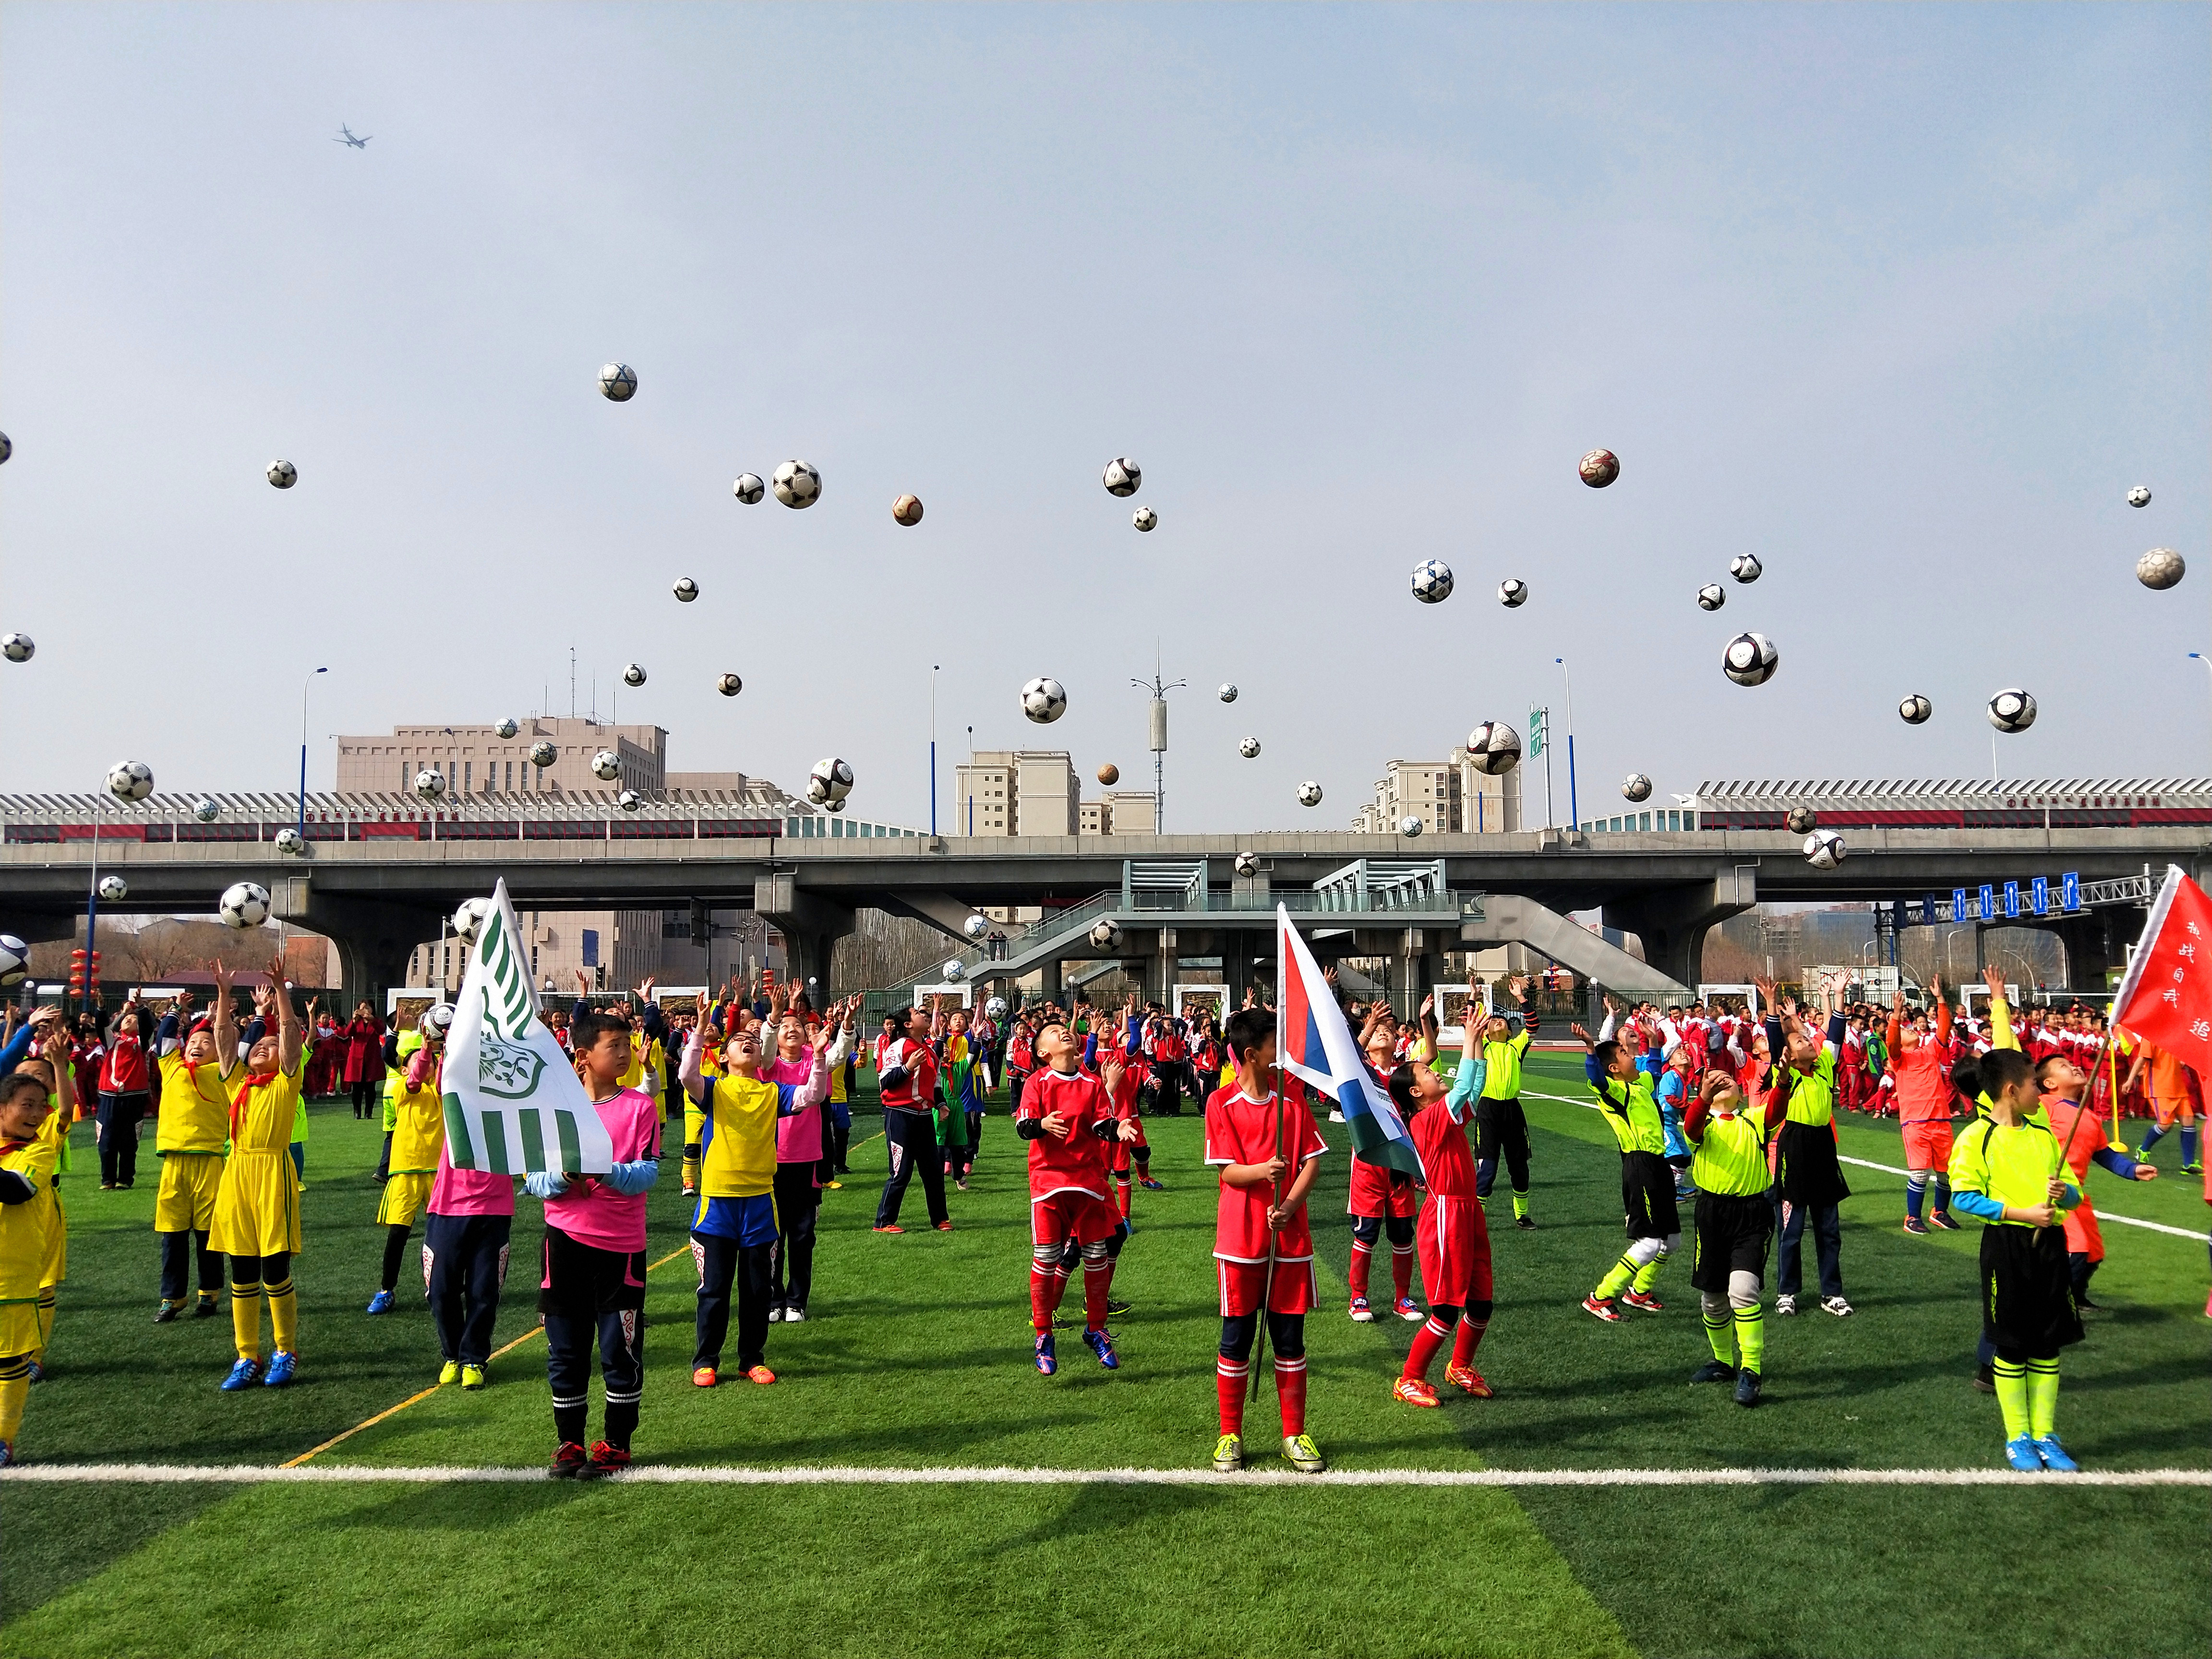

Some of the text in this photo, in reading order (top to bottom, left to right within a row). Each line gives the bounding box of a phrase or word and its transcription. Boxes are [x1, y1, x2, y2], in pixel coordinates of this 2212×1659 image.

[2162, 920, 2201, 1009] 挑战自我
[2189, 1017, 2211, 1042] 追
